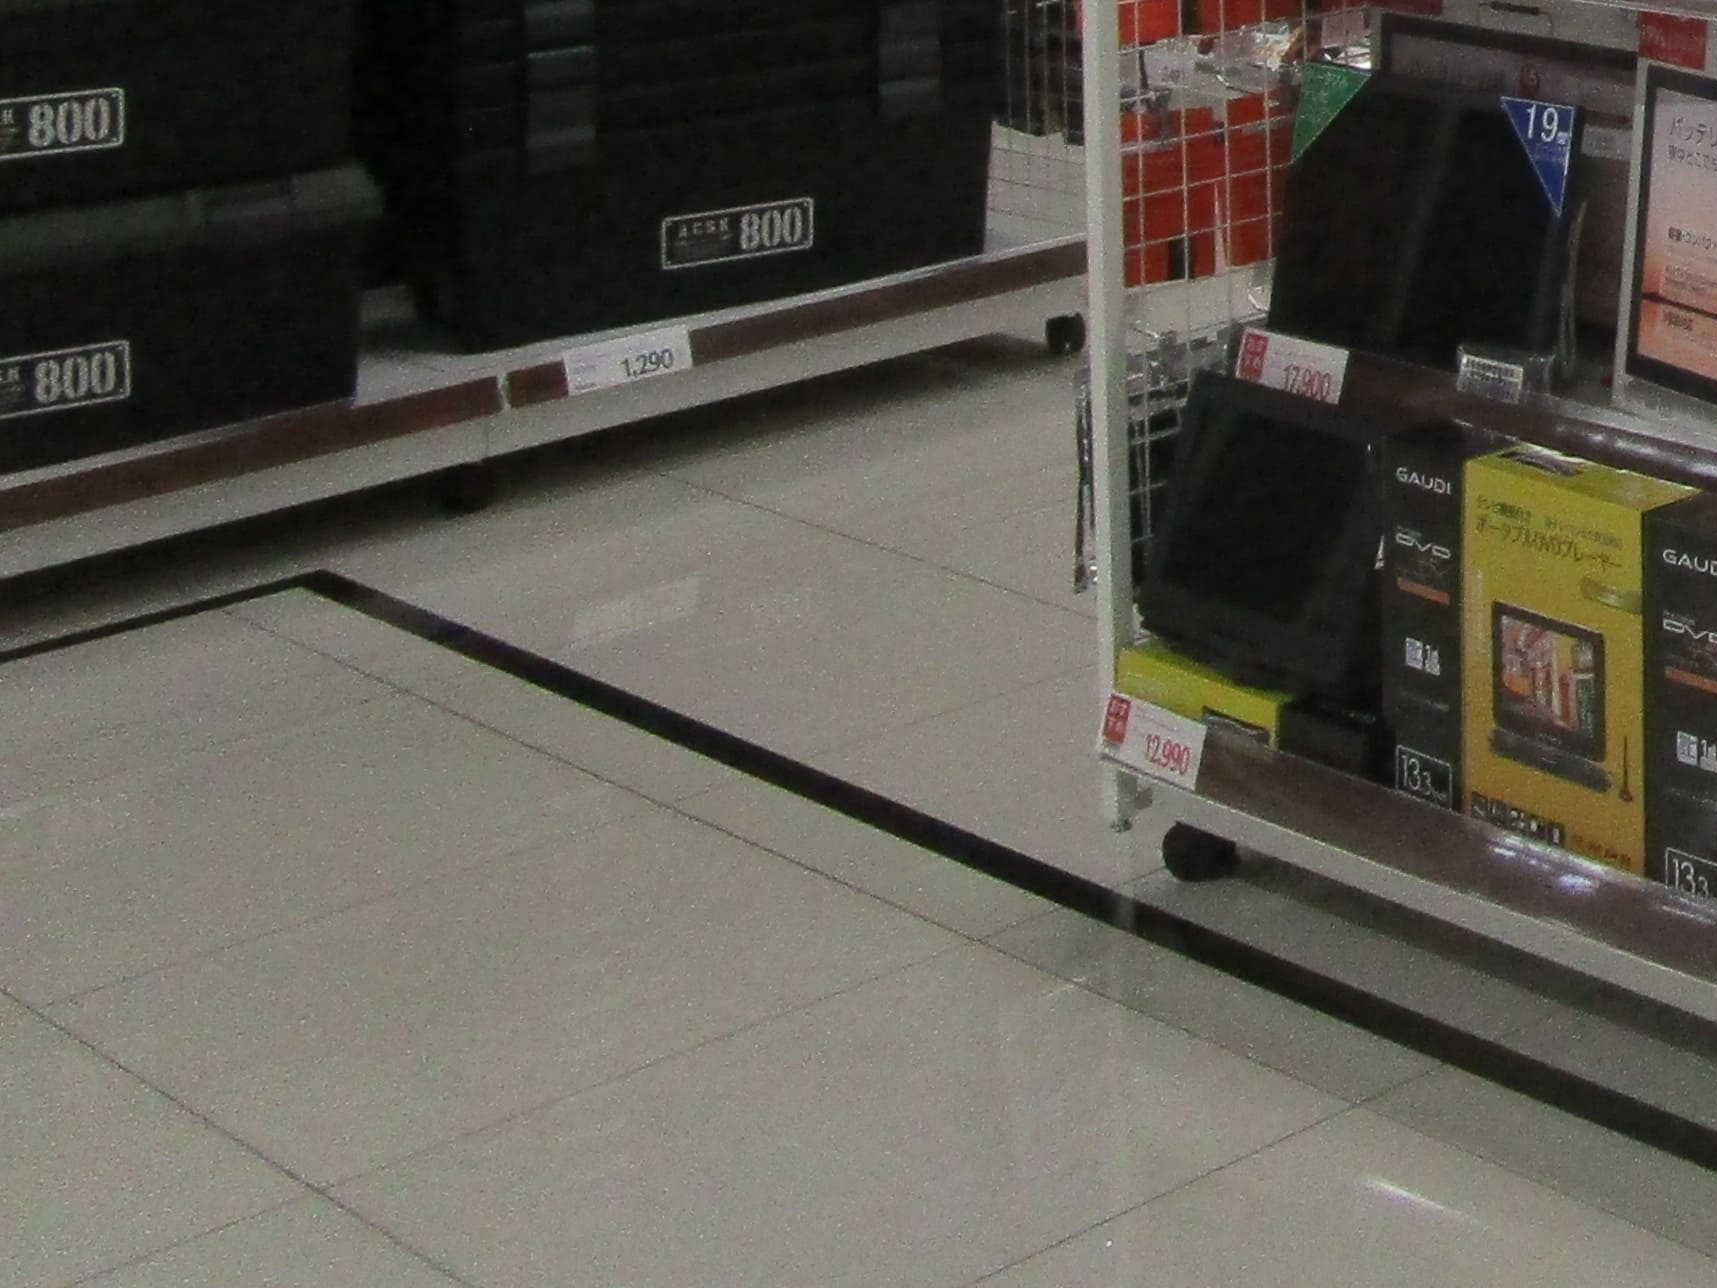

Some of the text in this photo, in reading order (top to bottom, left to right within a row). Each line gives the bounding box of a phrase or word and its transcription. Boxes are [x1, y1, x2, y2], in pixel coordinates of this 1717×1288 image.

[28, 97, 111, 147] 800
[739, 207, 803, 251] 800
[33, 351, 116, 404] 800
[619, 346, 675, 378] 1,290
[1395, 467, 1453, 496] GAUDI
